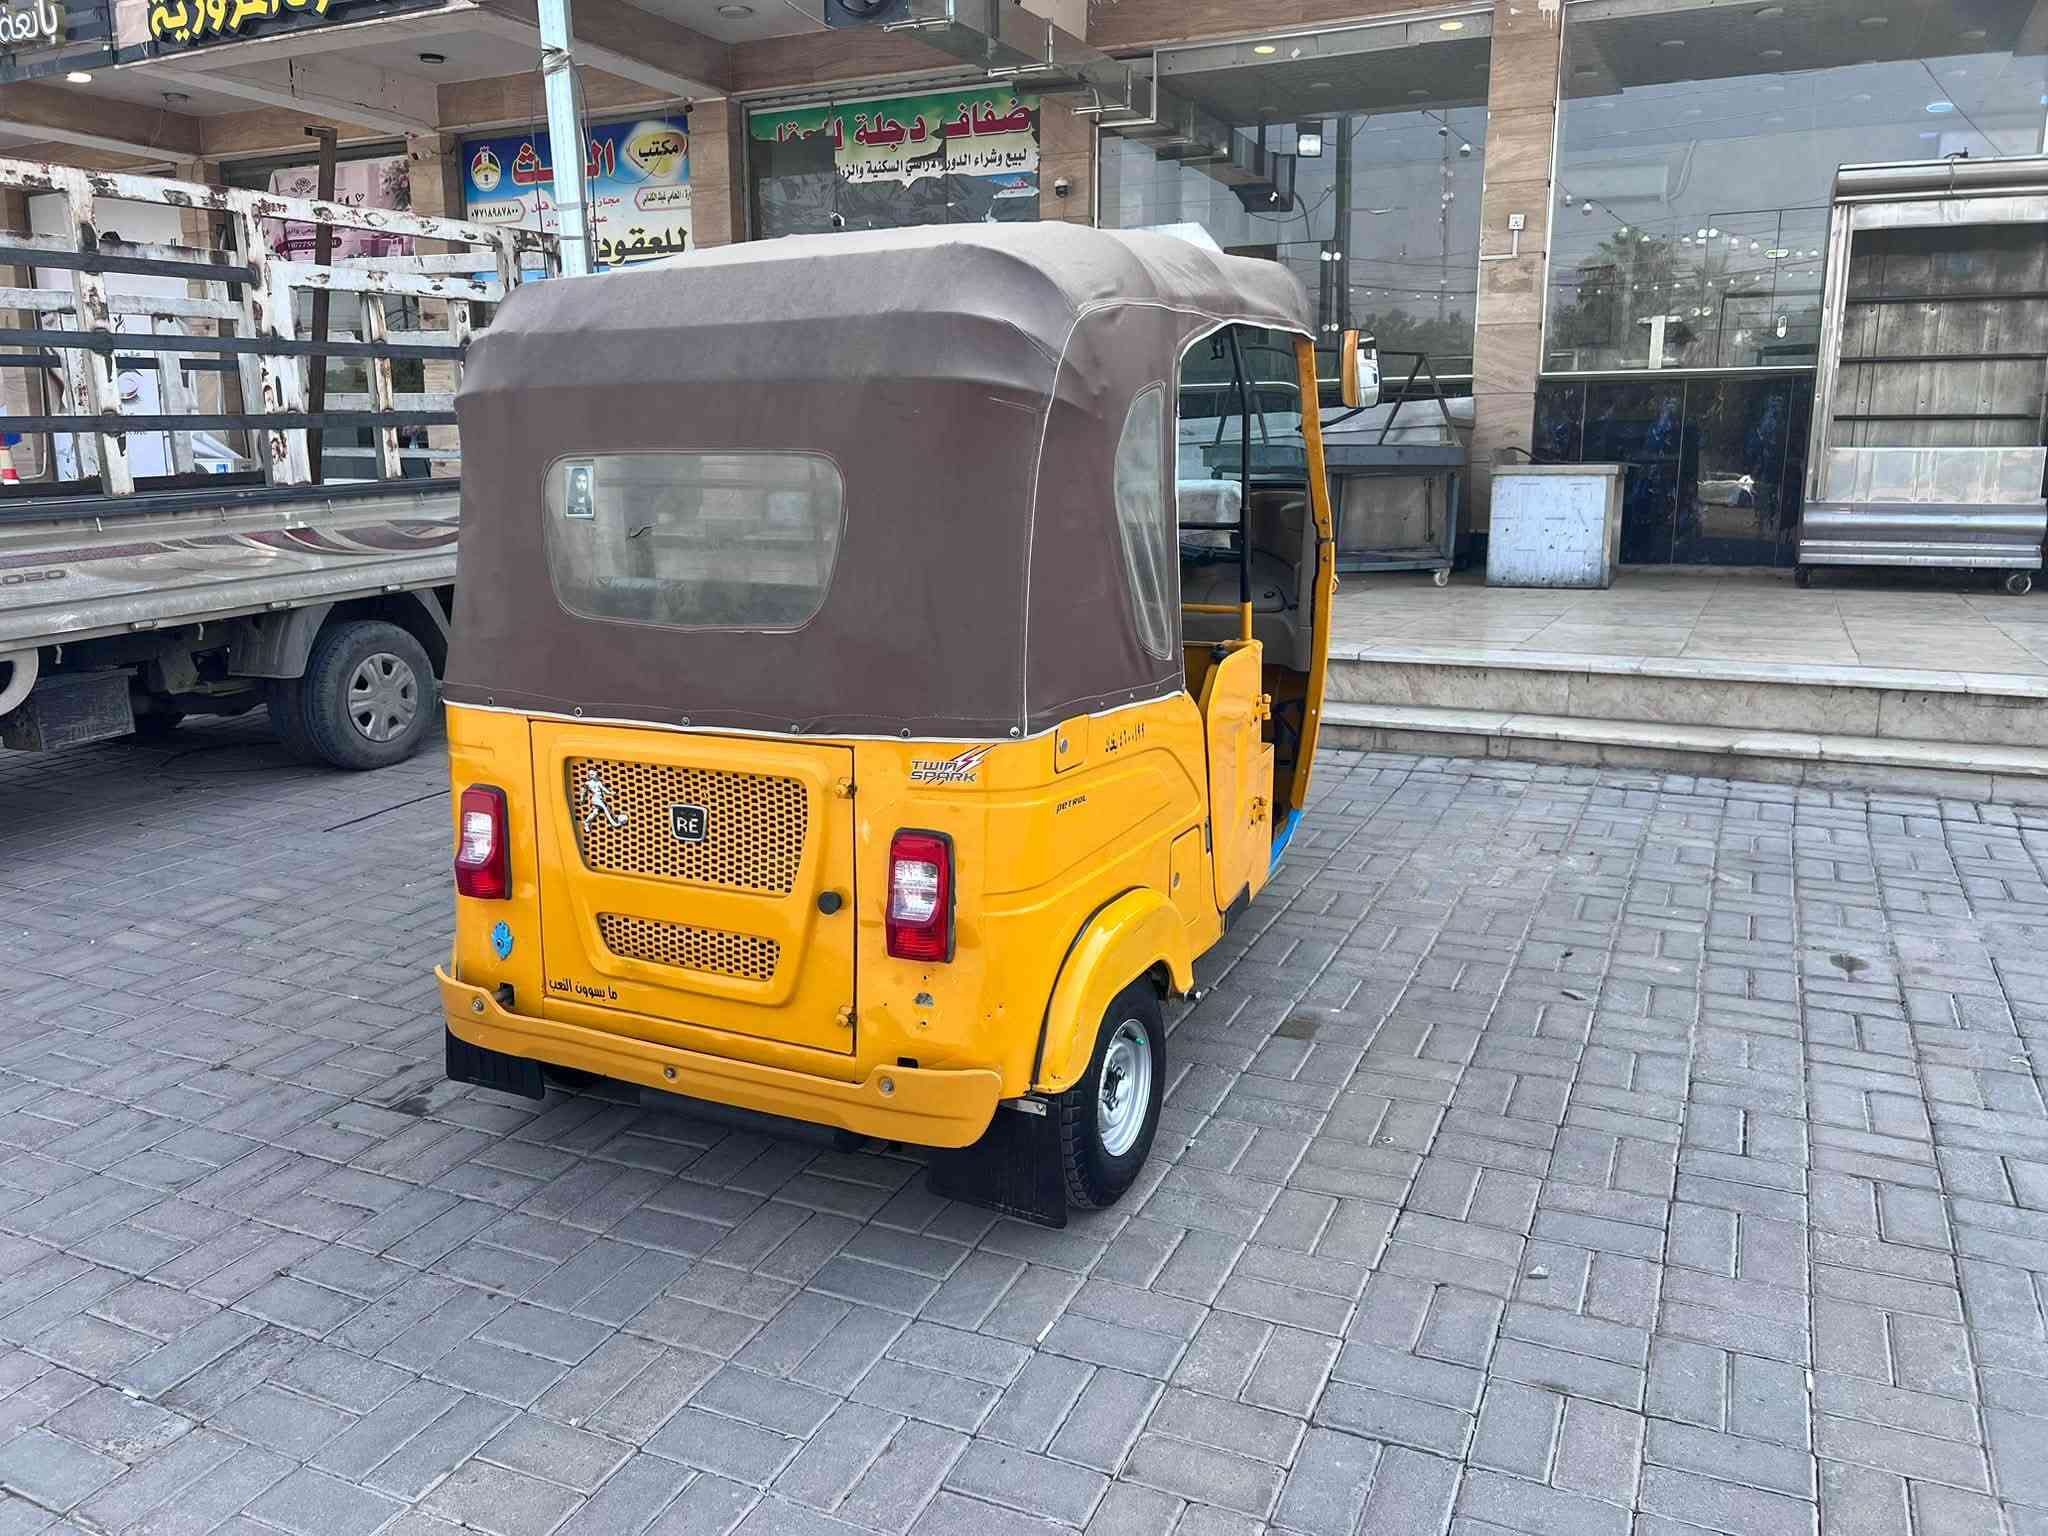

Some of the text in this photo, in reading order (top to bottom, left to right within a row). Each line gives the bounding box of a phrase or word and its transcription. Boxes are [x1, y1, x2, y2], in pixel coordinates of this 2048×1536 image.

[943, 97, 1033, 140] ضفاف
[854, 111, 928, 152] دجلة
[637, 137, 680, 162] مكتب
[973, 149, 1003, 167] وشراء
[1005, 148, 1027, 167] لبيع
[838, 163, 865, 179] والزرا
[866, 158, 903, 178] السكنية
[599, 226, 689, 265] للعقود
[911, 759, 958, 771] TWIN
[910, 770, 977, 782] SPARK
[676, 816, 699, 834] RE
[608, 984, 619, 1000] ما
